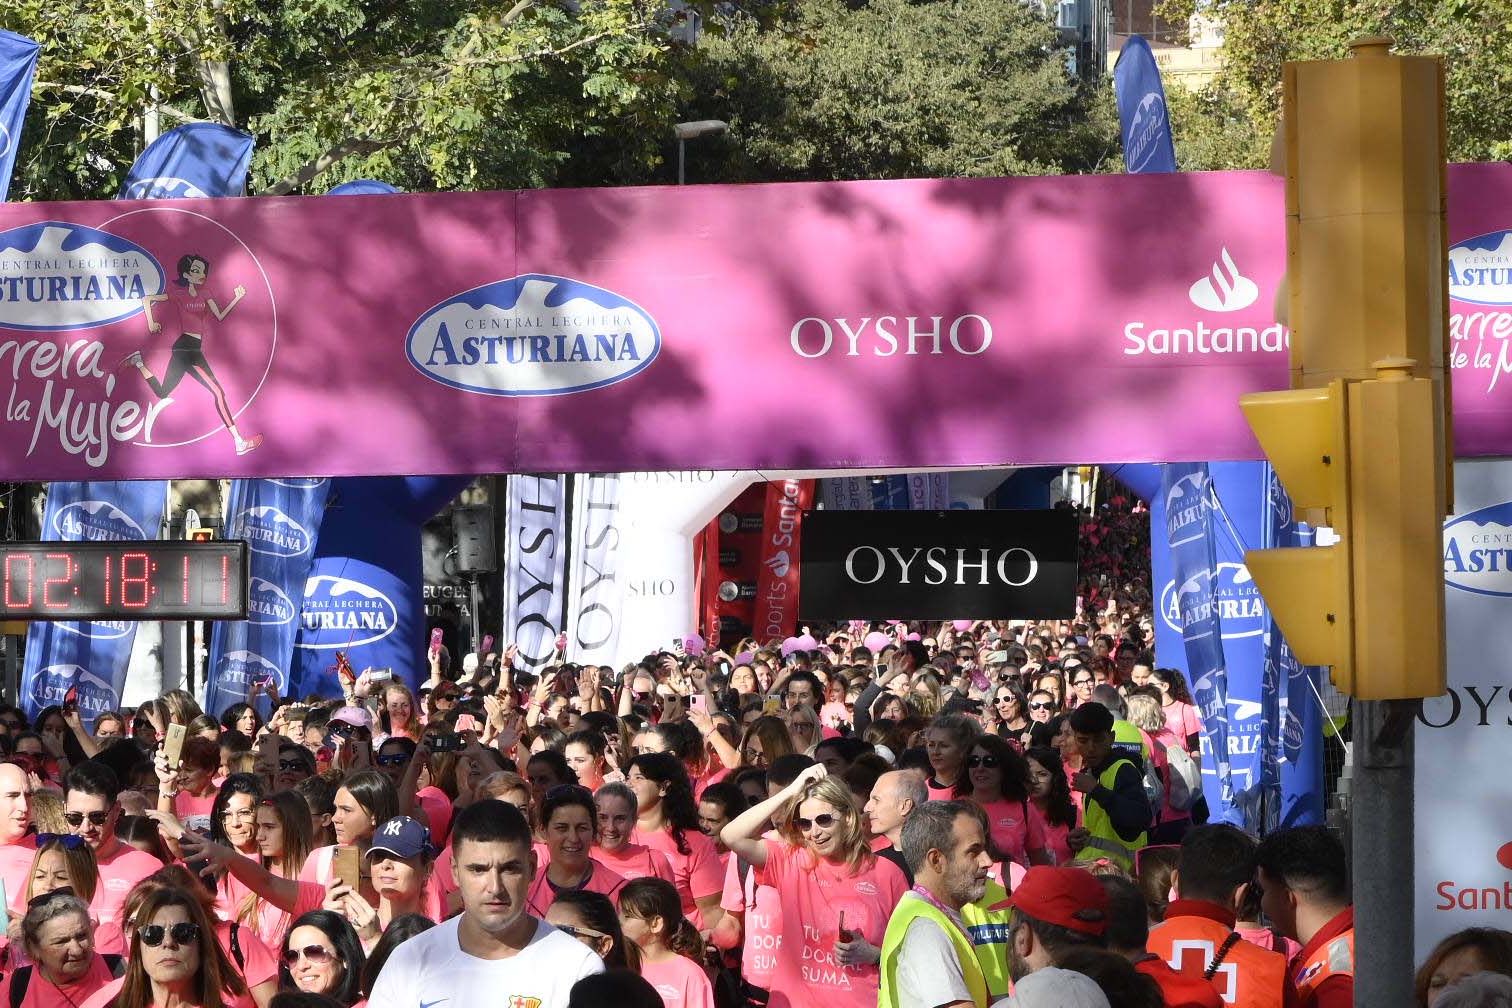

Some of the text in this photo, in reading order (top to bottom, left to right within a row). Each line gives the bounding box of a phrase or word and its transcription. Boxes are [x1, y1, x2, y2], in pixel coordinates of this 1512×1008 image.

[69, 257, 141, 270] LECHERA
[1448, 258, 1512, 287] ASTU
[464, 314, 634, 330] CENTRAL LECHERA
[790, 313, 994, 358] OYSHO
[424, 322, 641, 367] ASTURIANA
[1124, 321, 1289, 355] Santand
[1473, 340, 1493, 369] la
[6, 384, 31, 422] la
[26, 377, 173, 467] Mujer
[4, 552, 230, 608] 02:18:11
[515, 475, 558, 668] OYSH
[844, 545, 1039, 587] OYSHO
[334, 600, 384, 609] LECHERA
[300, 611, 388, 630] TURIANA
[1415, 684, 1512, 729] OY
[753, 915, 769, 928] TU
[804, 925, 820, 942] TU
[801, 965, 851, 986] SUMA
